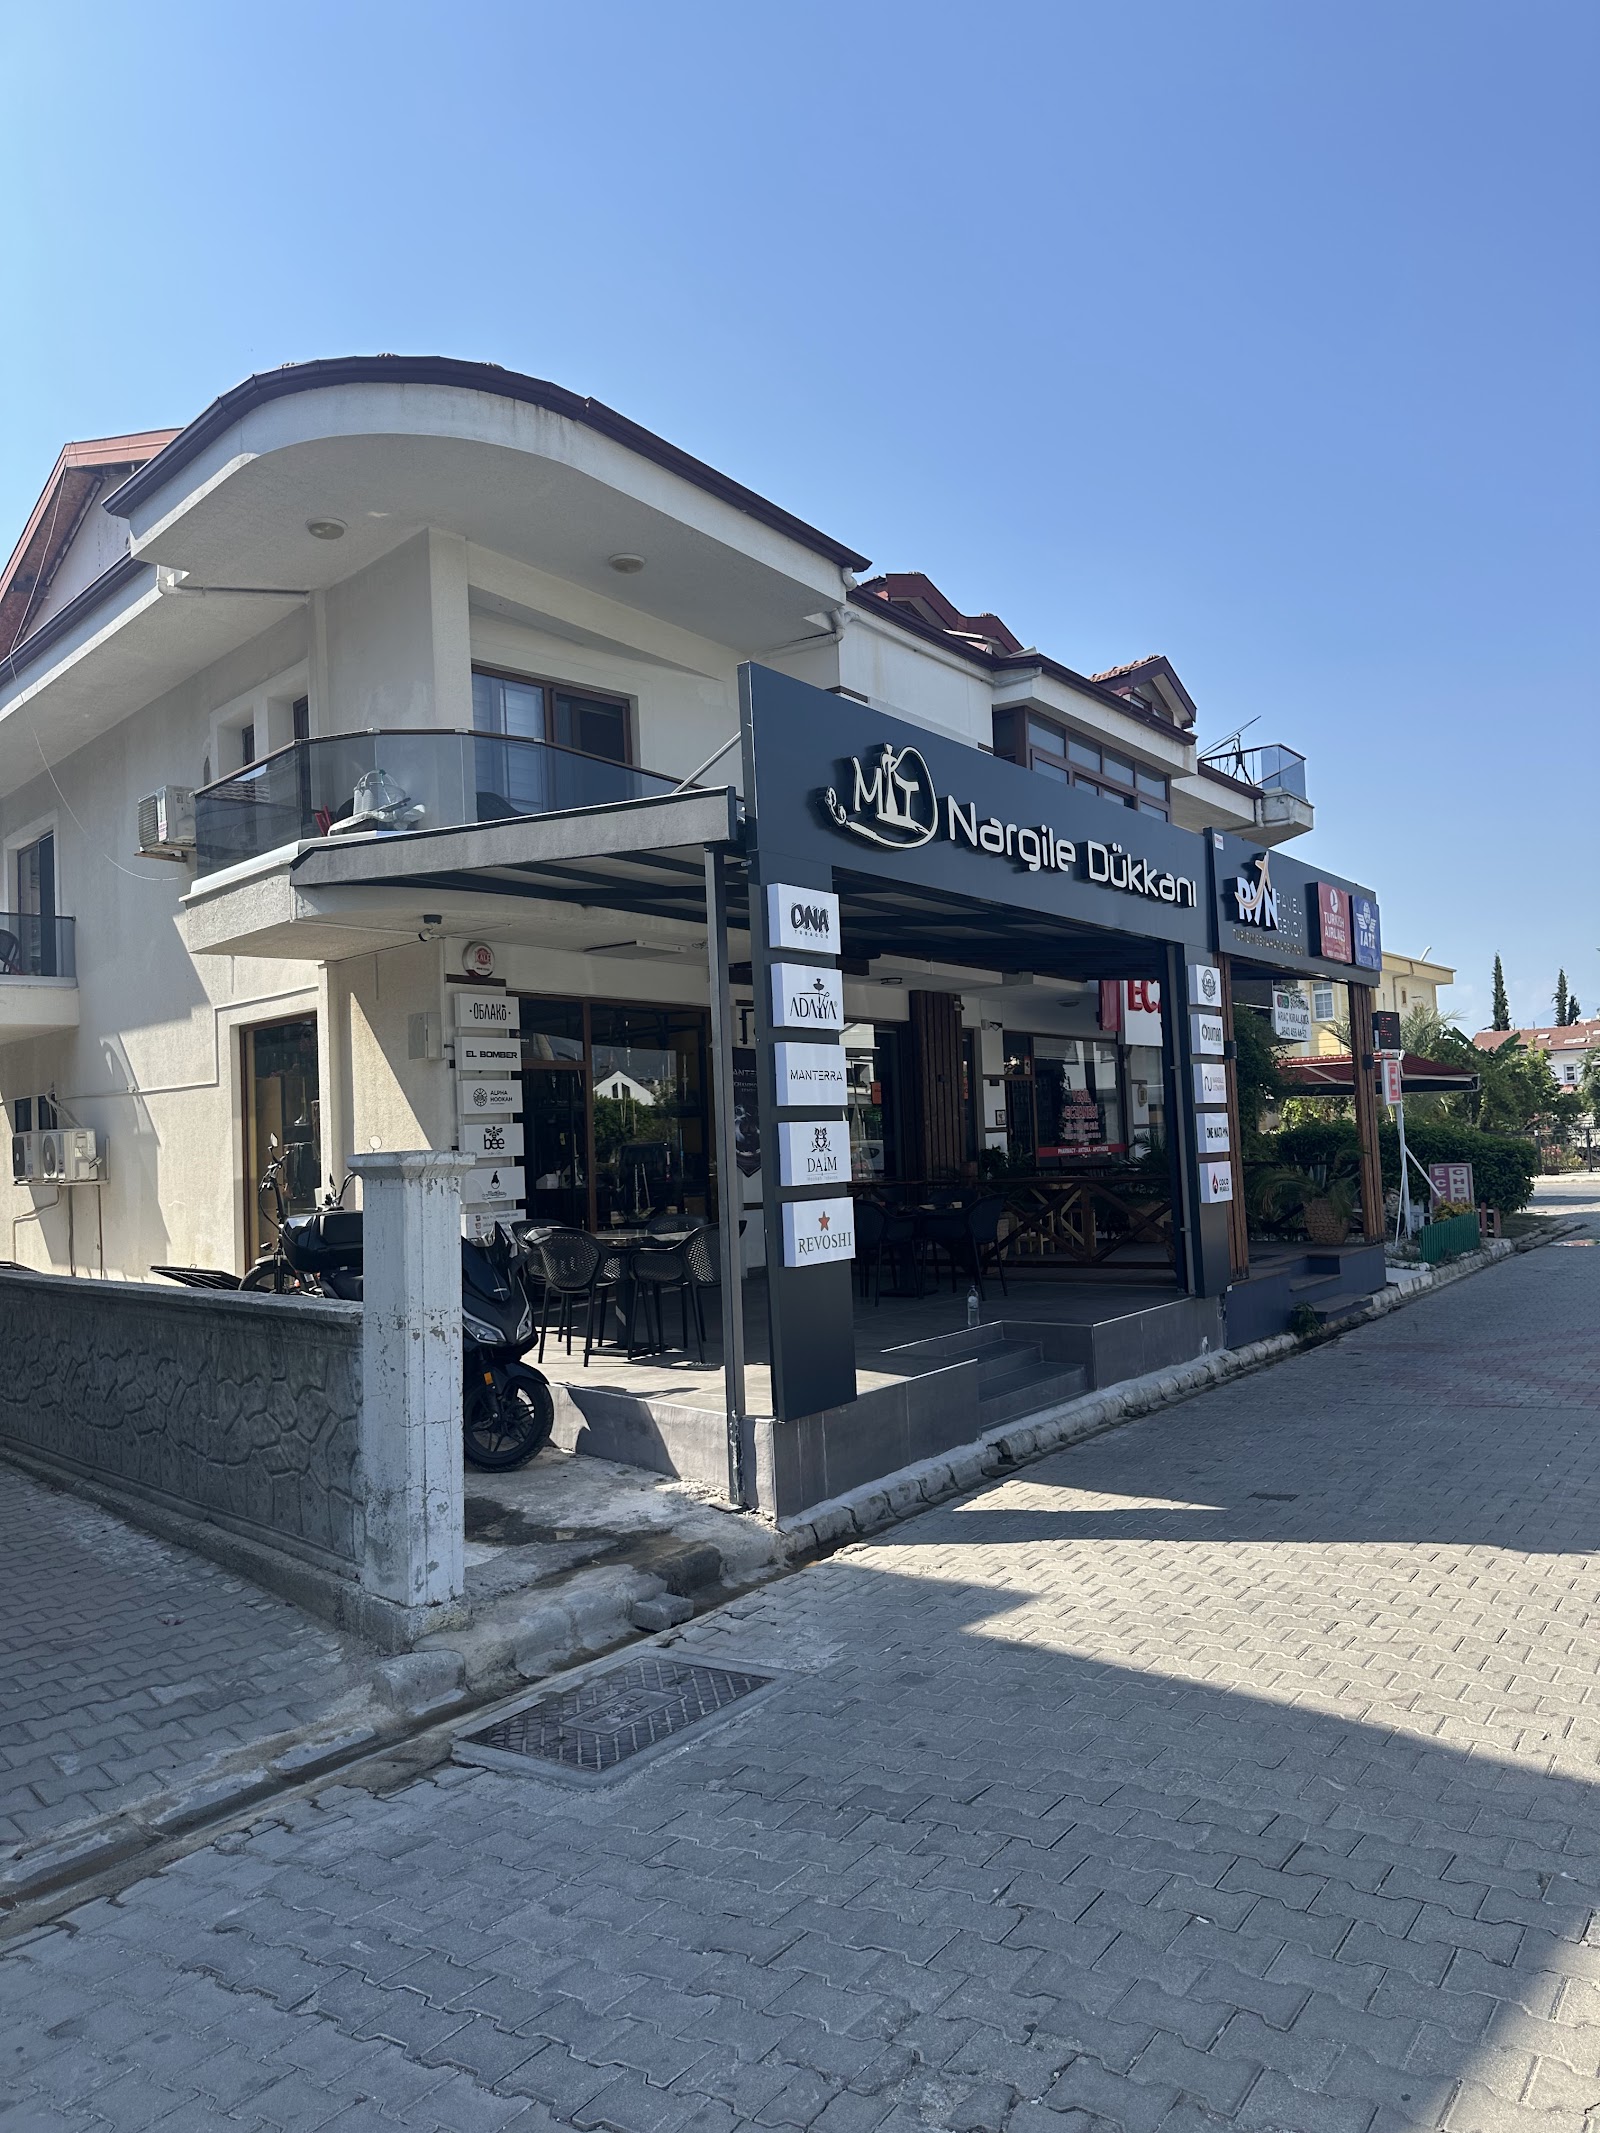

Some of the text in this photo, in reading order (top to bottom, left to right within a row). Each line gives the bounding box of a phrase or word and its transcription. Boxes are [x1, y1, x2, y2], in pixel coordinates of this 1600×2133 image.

[947, 795, 1198, 908] Nargile Dükkanı
[1236, 876, 1279, 930] RYN
[1276, 892, 1303, 916] RAVEL
[790, 903, 830, 934] ONA
[1278, 917, 1303, 938] GENCY
[1323, 911, 1345, 929] TURKISH
[794, 929, 829, 940] TOBACCO
[1324, 926, 1346, 943] AIRLINES
[1360, 930, 1375, 950] IATA
[1128, 979, 1161, 1014] EC
[465, 1050, 518, 1059] EL BOMBER
[790, 1069, 843, 1082] MANTERRA
[490, 1089, 508, 1097] ALPHA
[490, 1095, 513, 1103] HOOKAH
[483, 1134, 505, 1150] bee
[1434, 1167, 1447, 1199] ECZ
[1452, 1168, 1467, 1203] CHEM
[797, 1231, 852, 1255] REVOSHI
